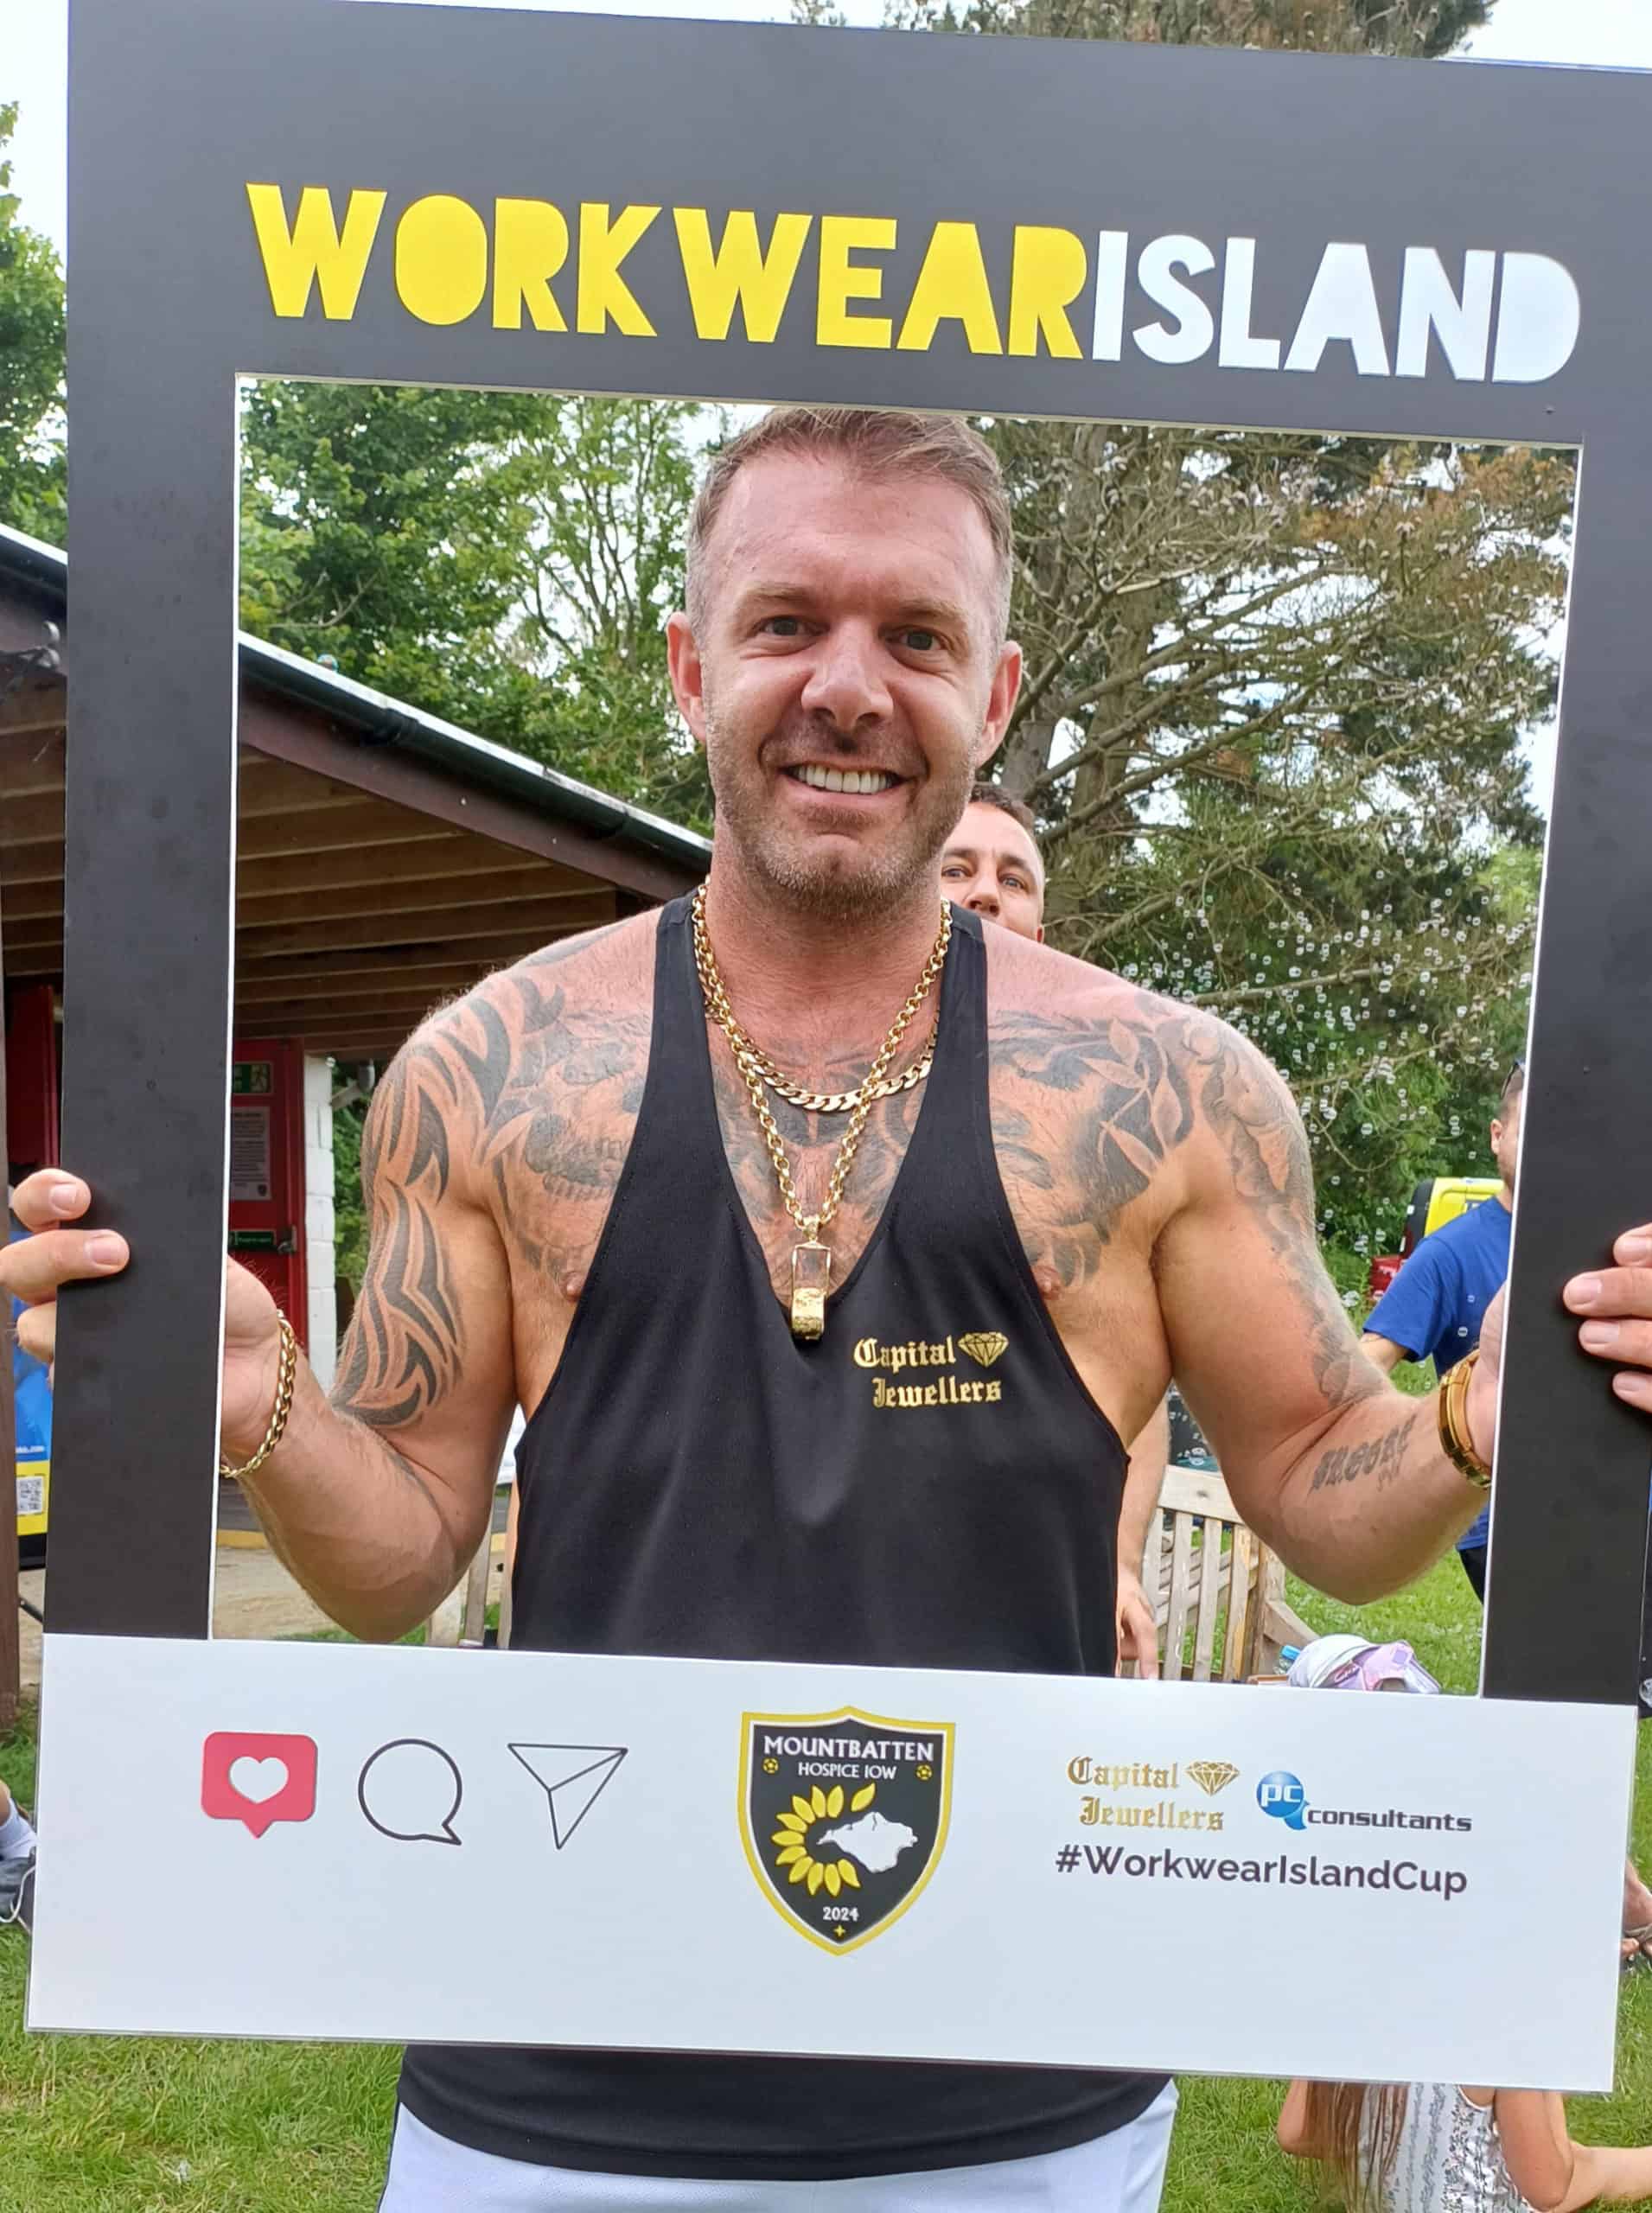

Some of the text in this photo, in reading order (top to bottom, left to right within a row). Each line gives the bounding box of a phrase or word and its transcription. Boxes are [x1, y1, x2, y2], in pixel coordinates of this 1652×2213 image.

[853, 1335, 956, 1374] Capital
[871, 1375, 1002, 1408] Jewellers
[763, 1735, 934, 1762] MOUNTBATTEN
[798, 1762, 897, 1780] HOSPICE IOW
[1067, 1756, 1179, 1791] Capital
[1079, 1795, 1224, 1831] Jewellers
[1260, 1783, 1473, 1832] pc consultants
[1056, 1843, 1468, 1901] #WorkwearIslandCup
[822, 1906, 858, 1922] 2024
